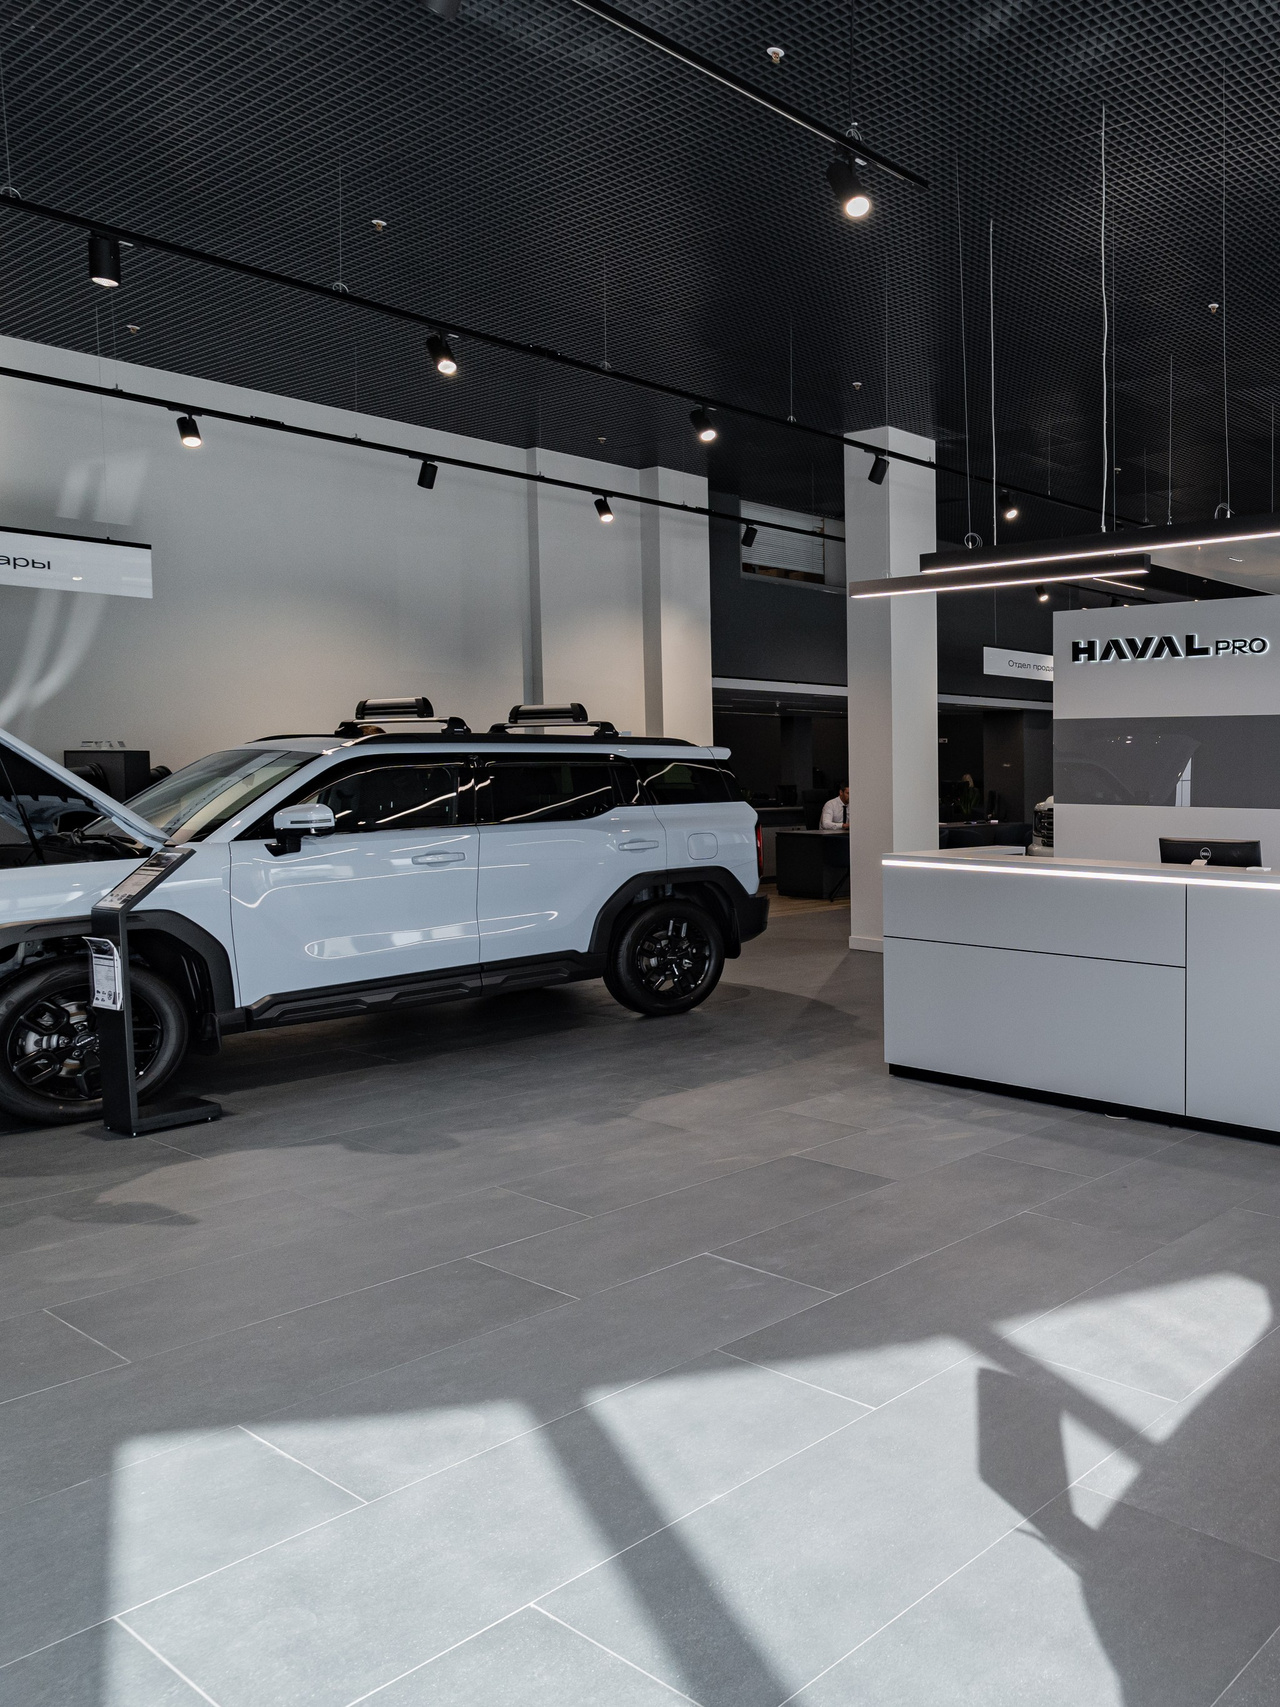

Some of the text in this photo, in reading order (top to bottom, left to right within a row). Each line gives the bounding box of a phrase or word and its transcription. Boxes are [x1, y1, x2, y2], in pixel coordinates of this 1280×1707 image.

[1071, 633, 1270, 663] HAVAL PRO
[1008, 659, 1031, 669] Отдел
